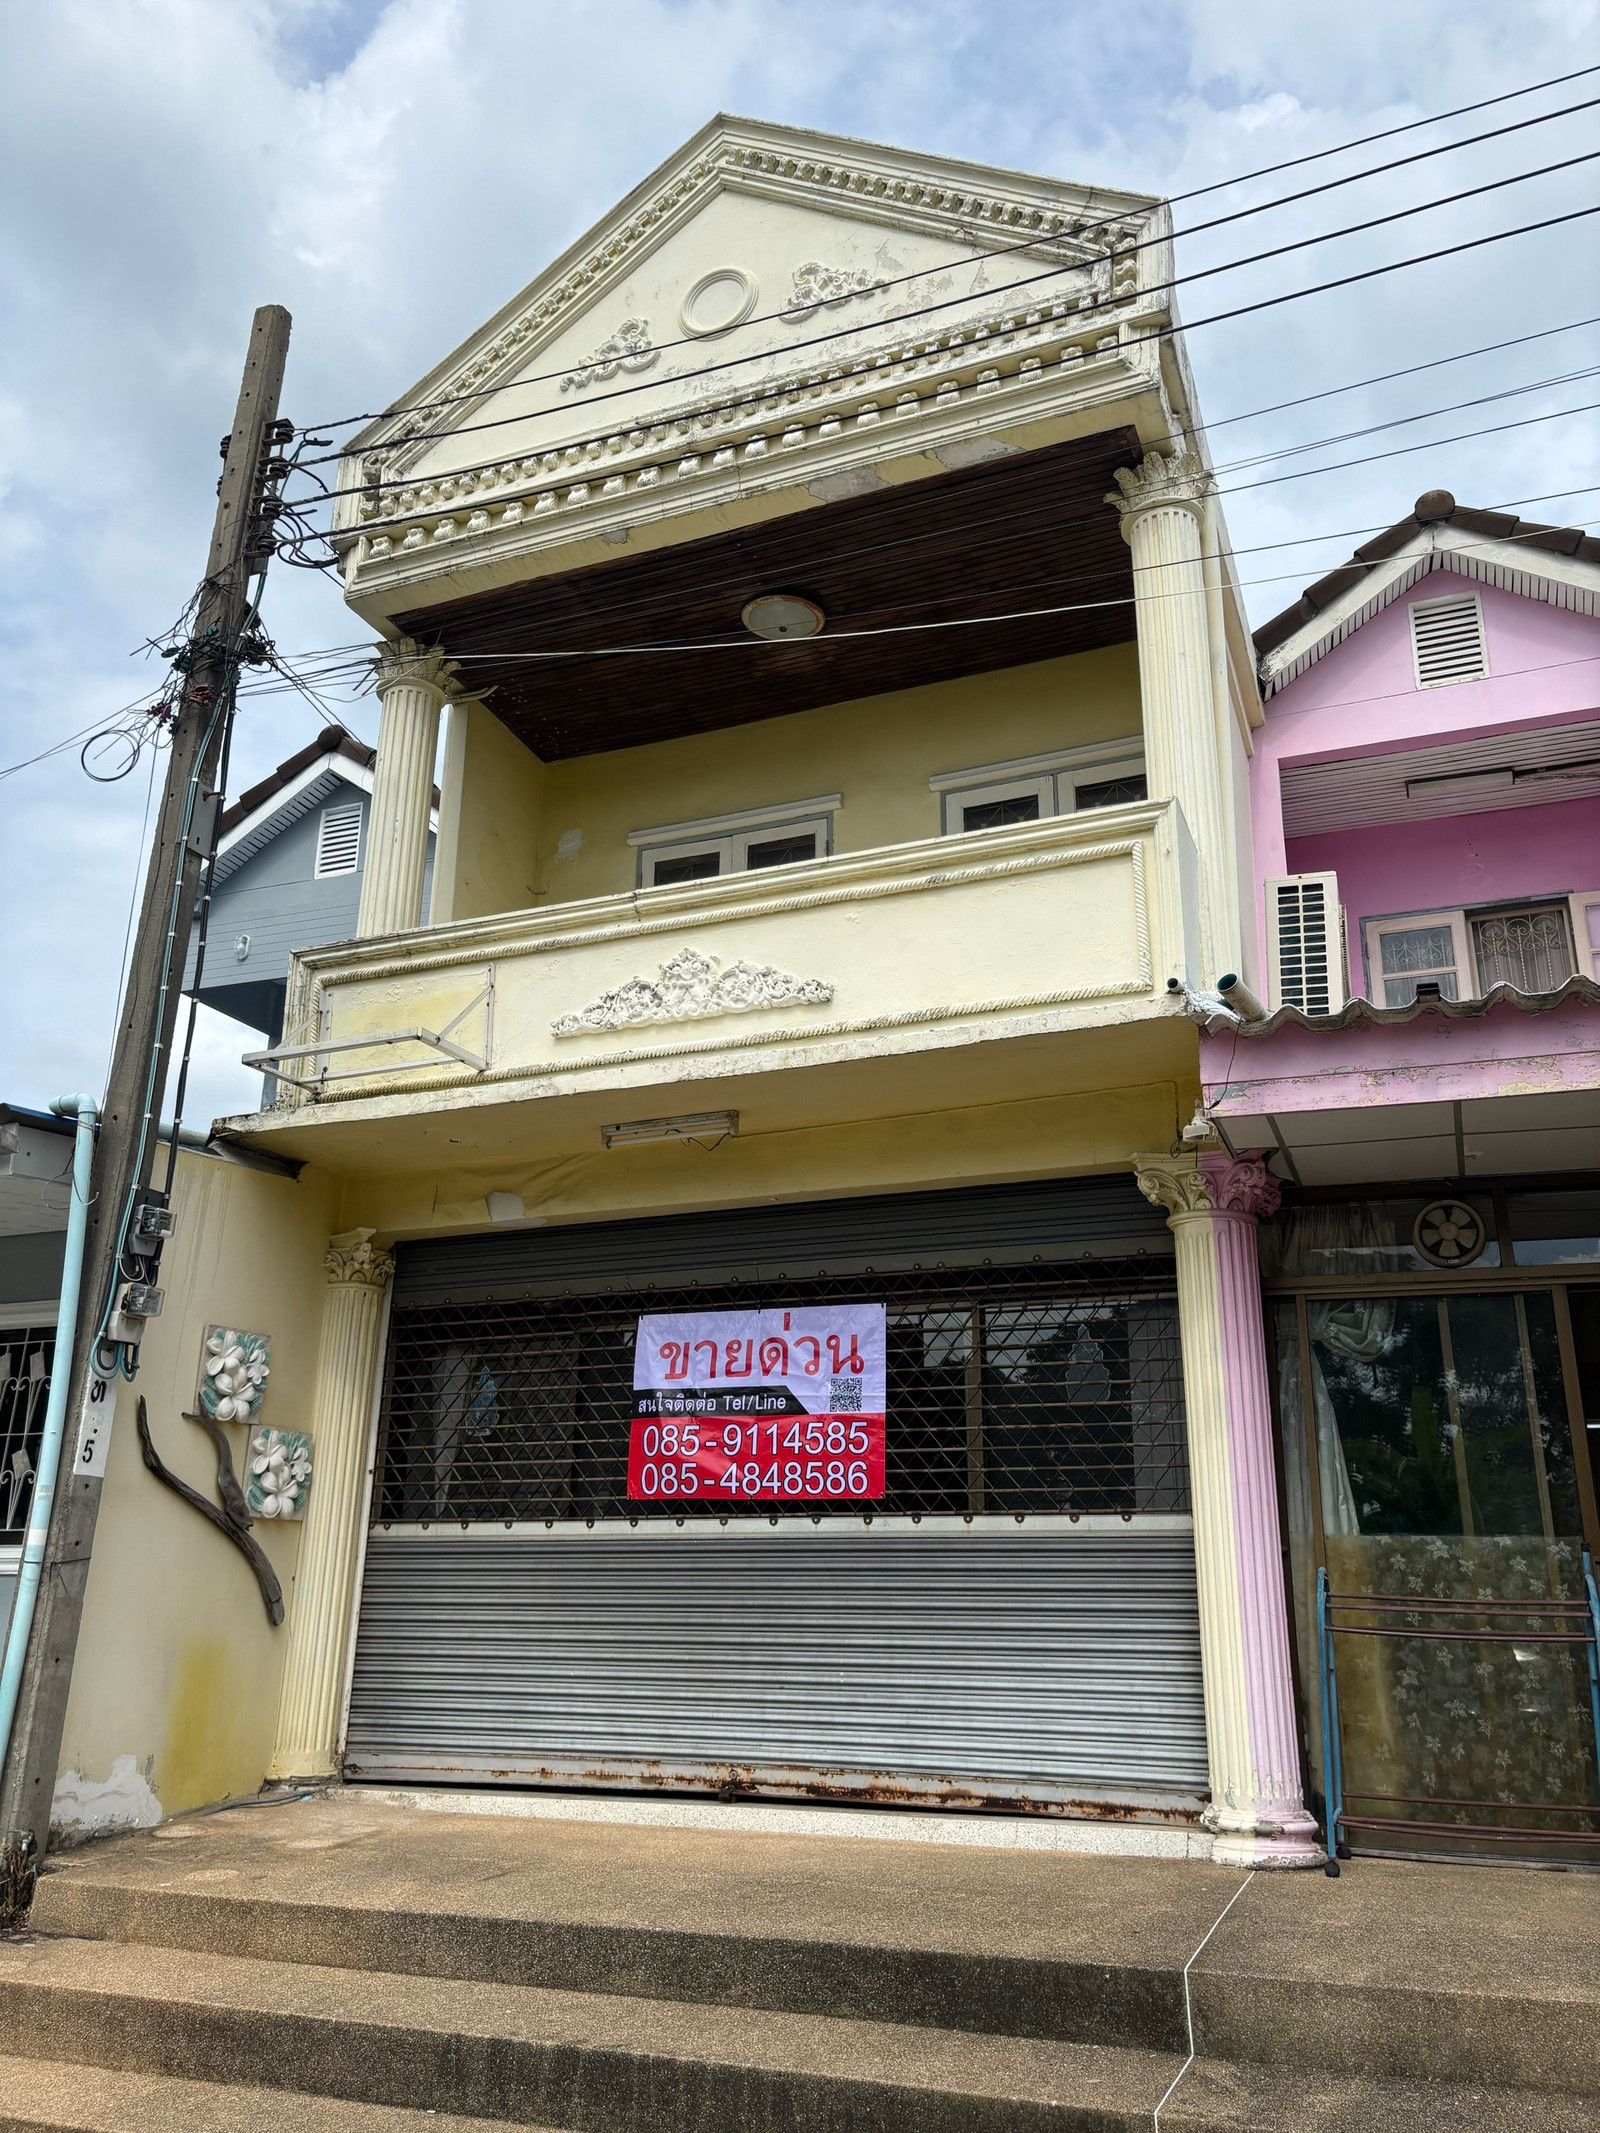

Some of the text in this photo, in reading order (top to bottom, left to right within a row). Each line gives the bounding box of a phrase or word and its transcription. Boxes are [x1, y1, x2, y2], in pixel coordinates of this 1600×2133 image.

[659, 1312, 865, 1380] ขายด่วน
[638, 1391, 787, 1413] สนใจติดต่อ Tel/Line
[82, 1439, 95, 1463] 5
[643, 1421, 869, 1457] 085-9114585
[640, 1460, 869, 1496] 085-4848586
